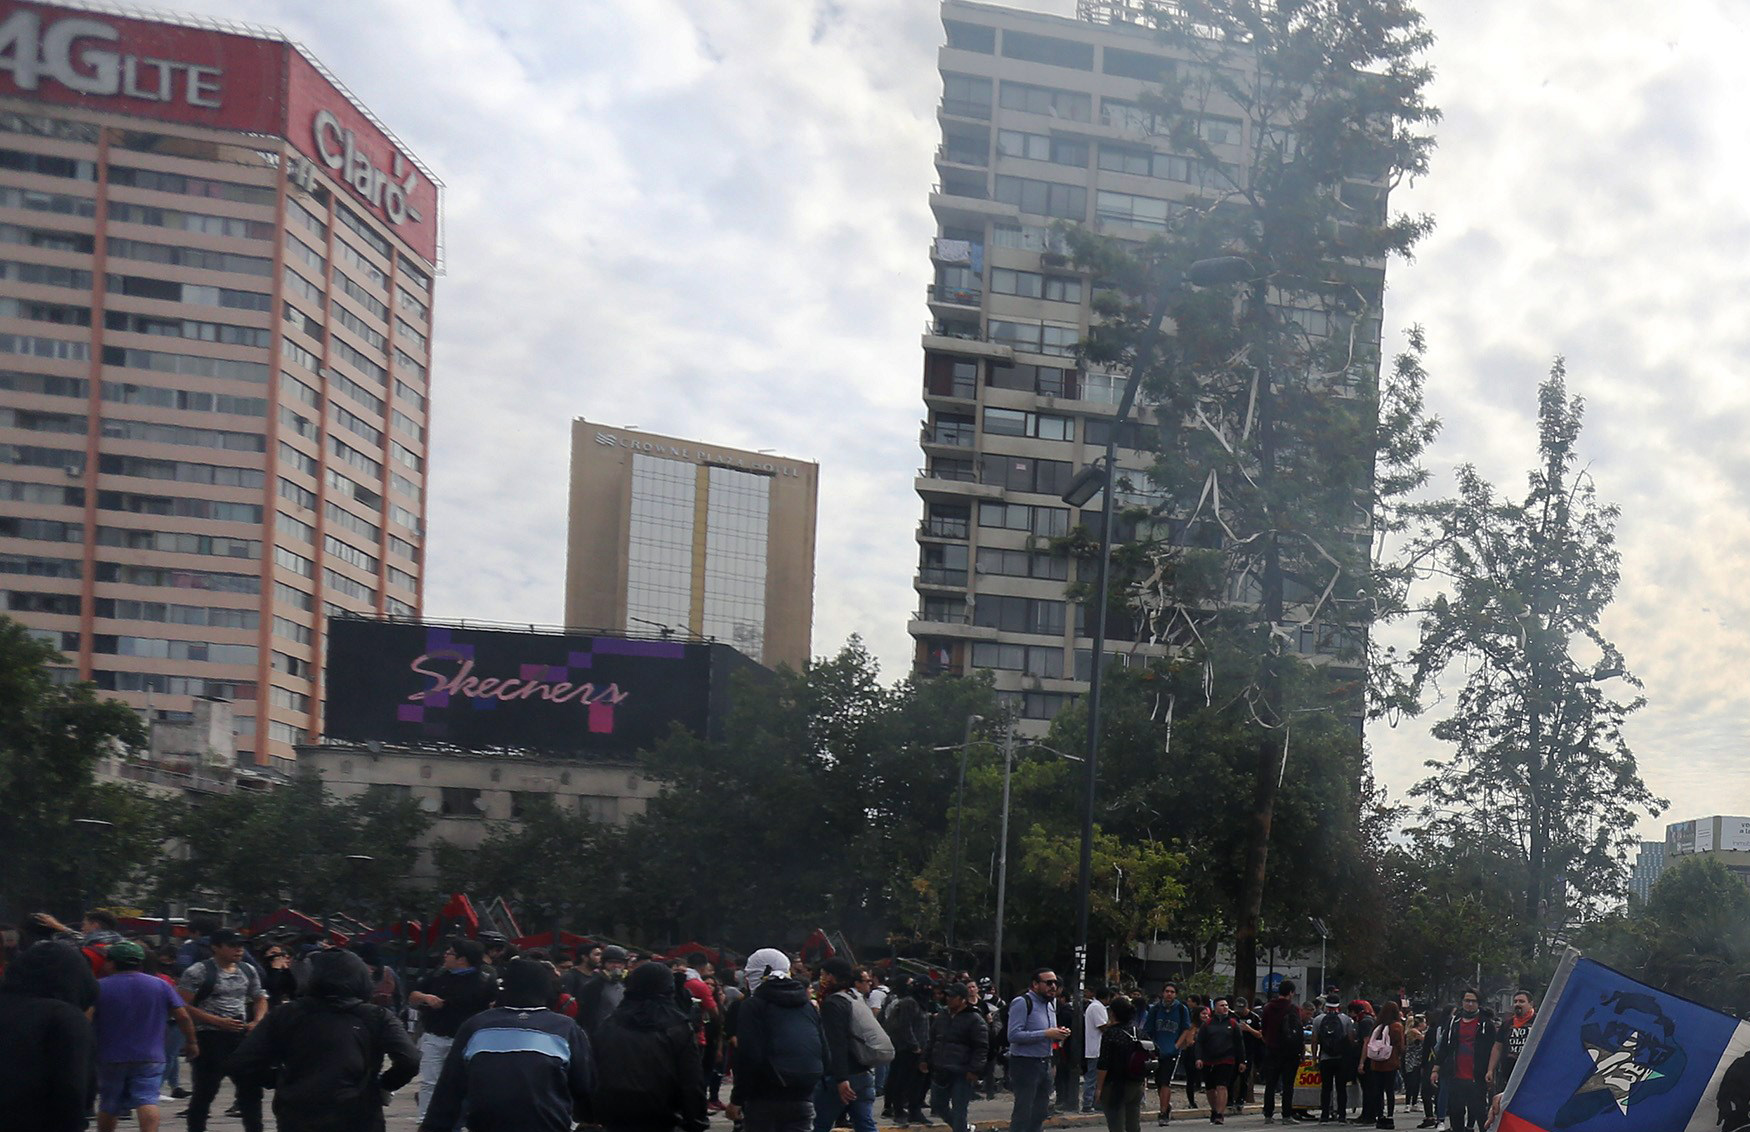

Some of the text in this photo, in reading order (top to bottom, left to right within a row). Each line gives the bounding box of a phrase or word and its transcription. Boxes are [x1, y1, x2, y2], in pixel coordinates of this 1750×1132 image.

[312, 109, 409, 226] Claro
[620, 439, 690, 459] CROWNE
[697, 450, 744, 466] PLAZA
[1299, 1073, 1322, 1085] 500
